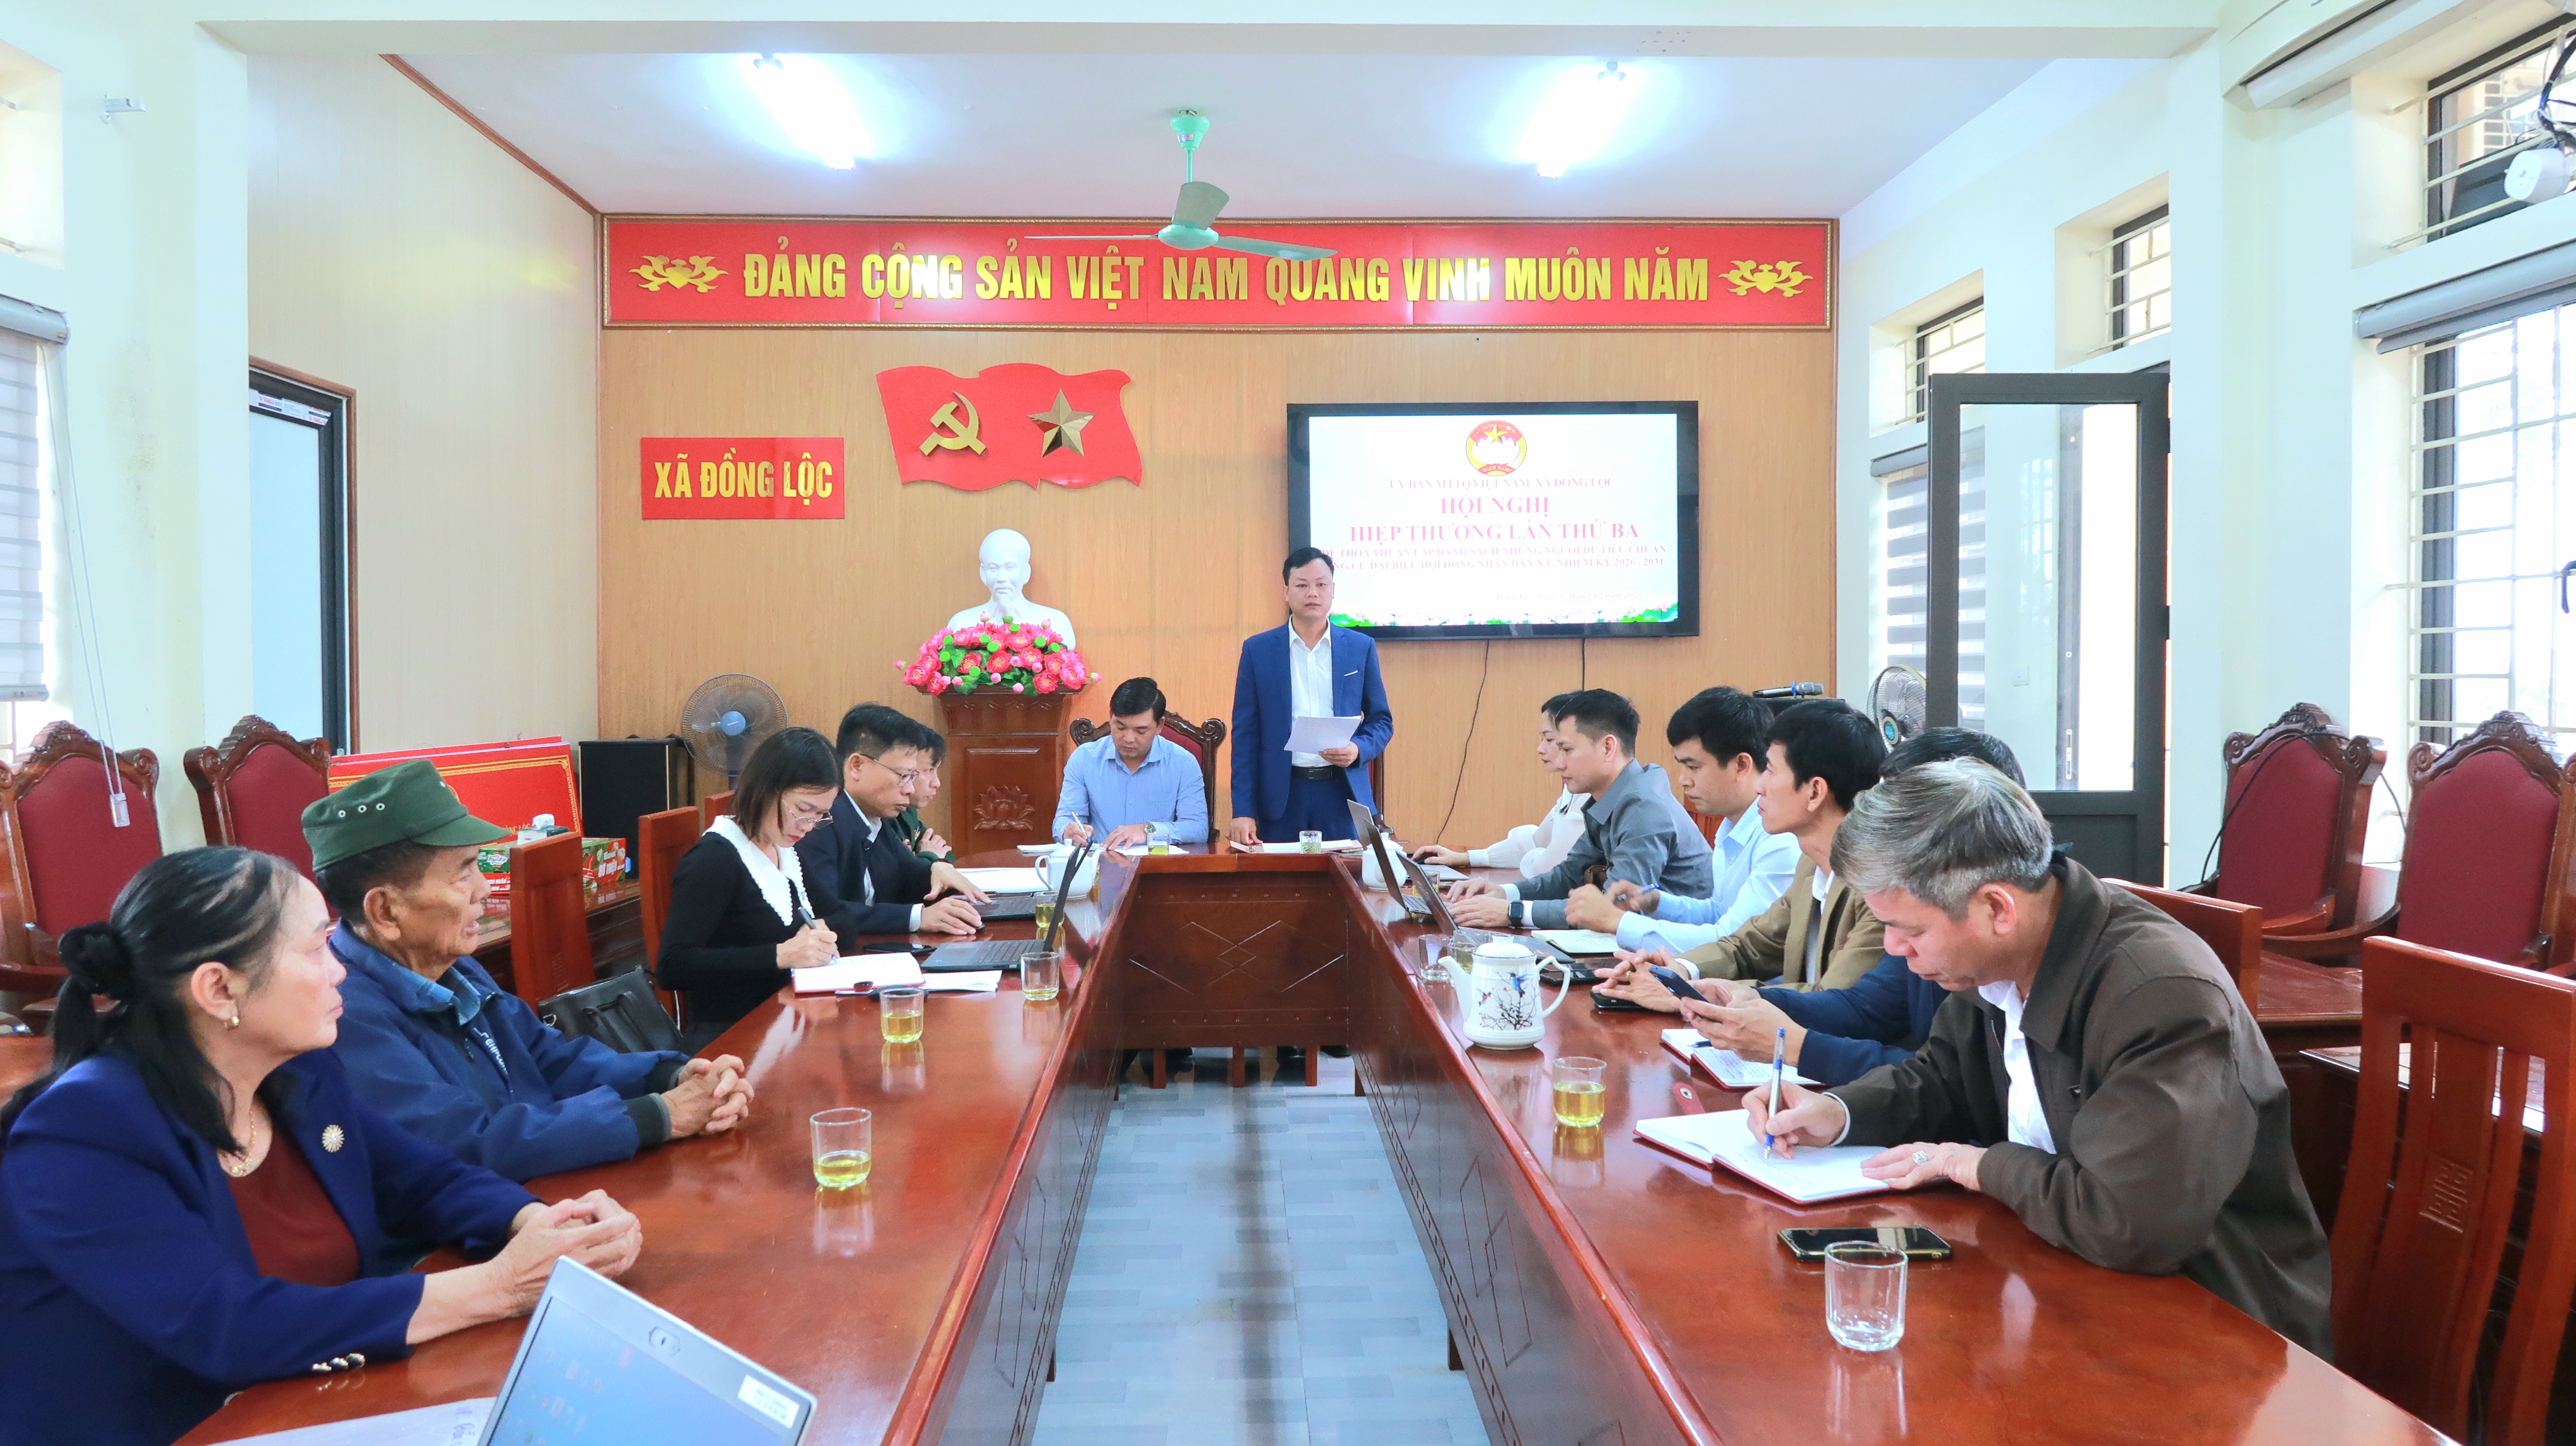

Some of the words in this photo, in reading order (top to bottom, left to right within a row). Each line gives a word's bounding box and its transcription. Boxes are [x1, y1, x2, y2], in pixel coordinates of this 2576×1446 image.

[743, 236, 846, 299] ĐẢNG
[862, 241, 963, 309] CỘNG
[975, 238, 1052, 300] SẢN
[1066, 245, 1144, 310] VIỆT
[1163, 257, 1248, 300] NAM
[1265, 257, 1390, 306] QUANG
[1401, 257, 1490, 301] VINH
[1505, 246, 1611, 301] MUÔN
[1624, 246, 1708, 301] NĂM
[654, 453, 692, 498] XÃ
[700, 447, 774, 498] ĐỒNG
[783, 452, 833, 506] LỘC
[1441, 494, 1482, 518] HỘI
[1491, 497, 1549, 517] NGHỊ
[1349, 522, 1401, 546] HIỆP
[1406, 522, 1501, 541] THƯƠNG
[1509, 519, 1552, 540] LẦN
[1558, 519, 1606, 539] THỨ
[1612, 523, 1639, 538] BA
[1614, 558, 1635, 567] 2026
[1643, 558, 1664, 566] 2031
